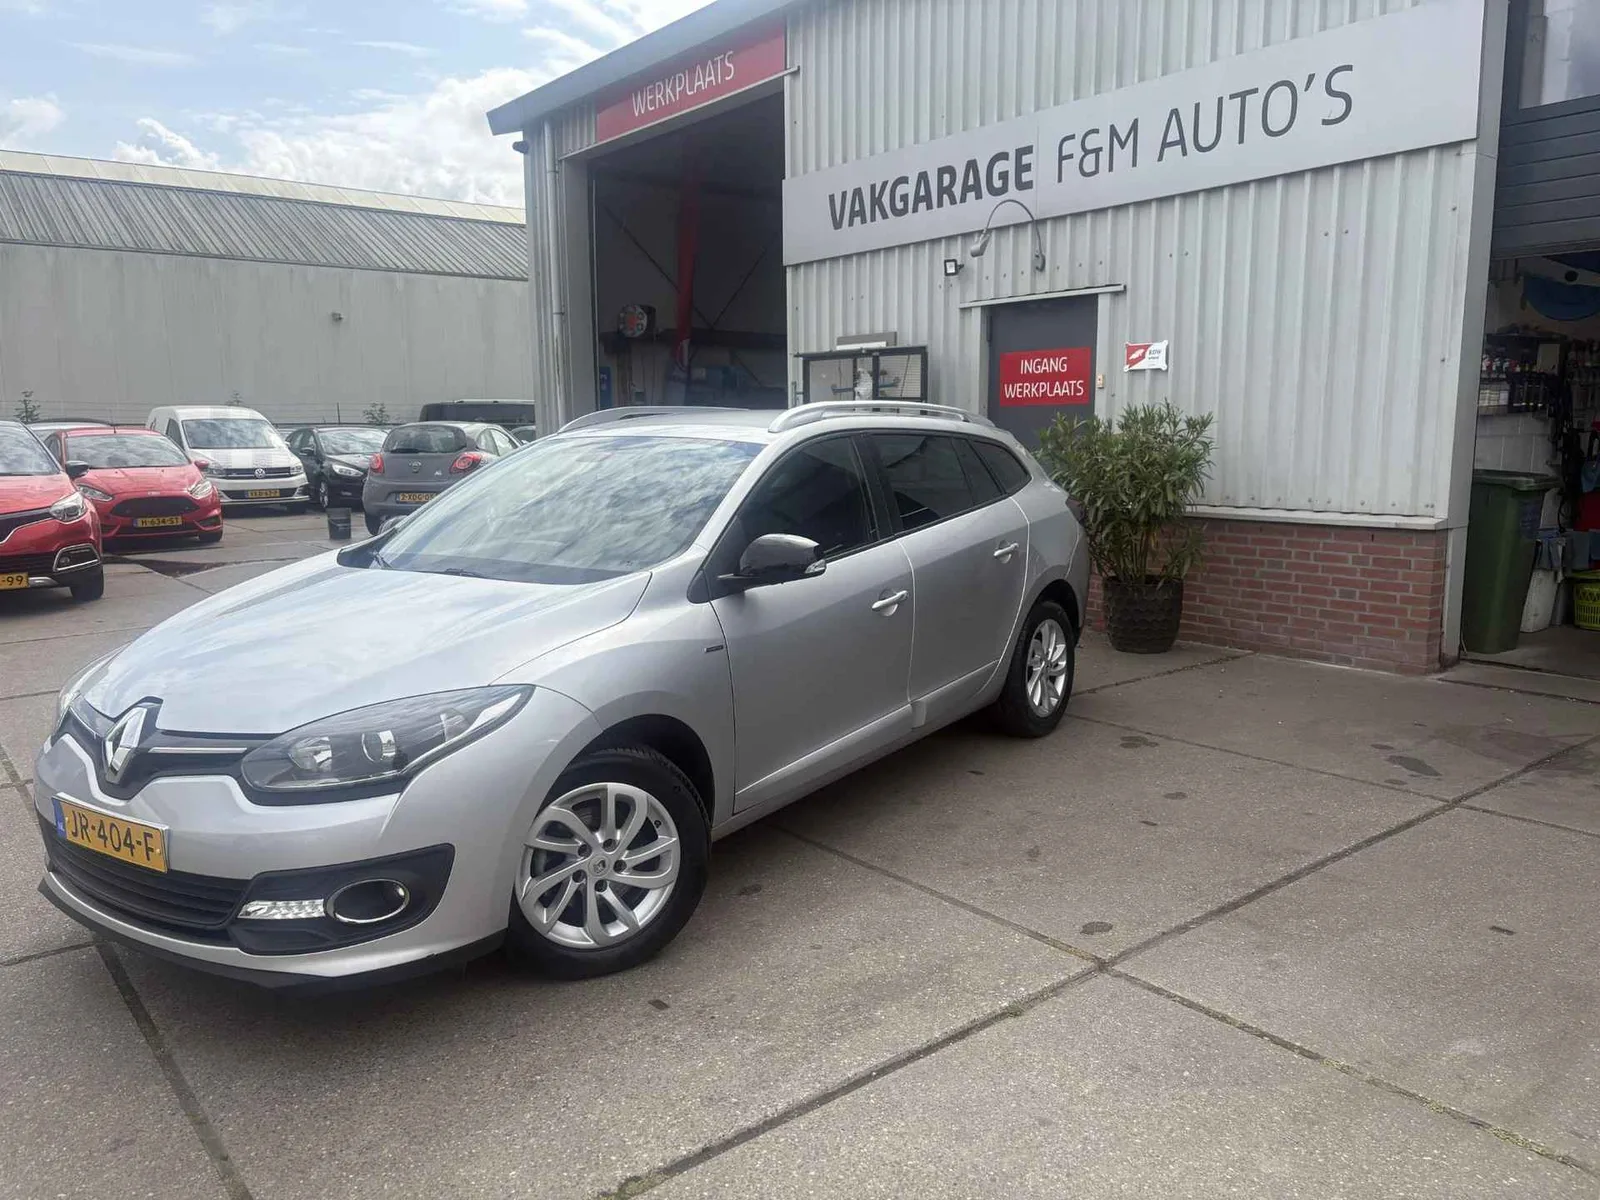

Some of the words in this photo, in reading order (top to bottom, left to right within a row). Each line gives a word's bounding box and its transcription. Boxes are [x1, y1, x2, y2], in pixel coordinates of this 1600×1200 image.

[632, 51, 735, 117] WERKPLAATS
[828, 145, 1034, 230] VAKGARAGE
[1056, 117, 1139, 184] F&M
[1157, 64, 1354, 162] AUTO'S
[1004, 380, 1084, 399] WERKPLAATS
[1020, 356, 1067, 375] INGANG
[71, 810, 154, 861] JR-404-F
